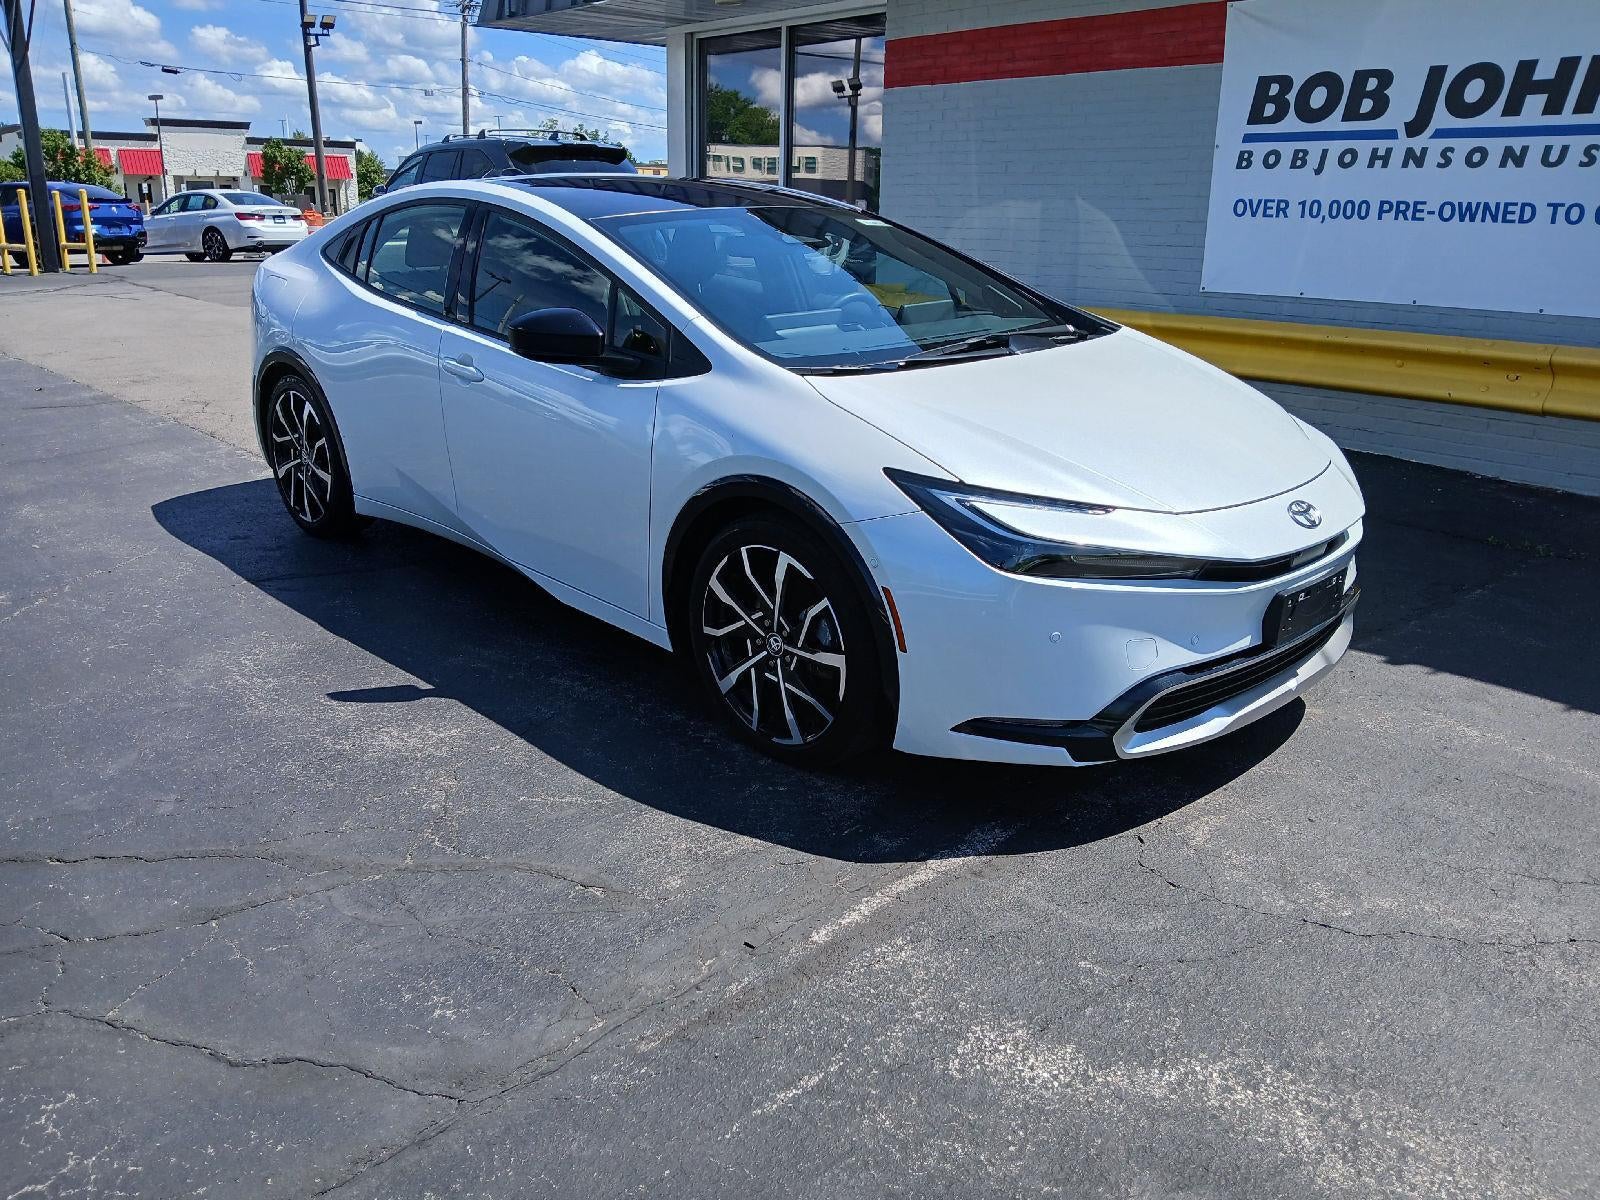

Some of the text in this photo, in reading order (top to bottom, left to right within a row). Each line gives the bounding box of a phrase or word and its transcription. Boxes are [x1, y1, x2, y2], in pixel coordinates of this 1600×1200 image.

[1246, 68, 1395, 126] BOB
[1235, 143, 1600, 176] BOBJOHNSONUS
[1232, 198, 1289, 218] OVER
[1297, 199, 1371, 224] 10,000
[1377, 200, 1537, 225] PRE-OWNED
[1546, 202, 1586, 226] TO
